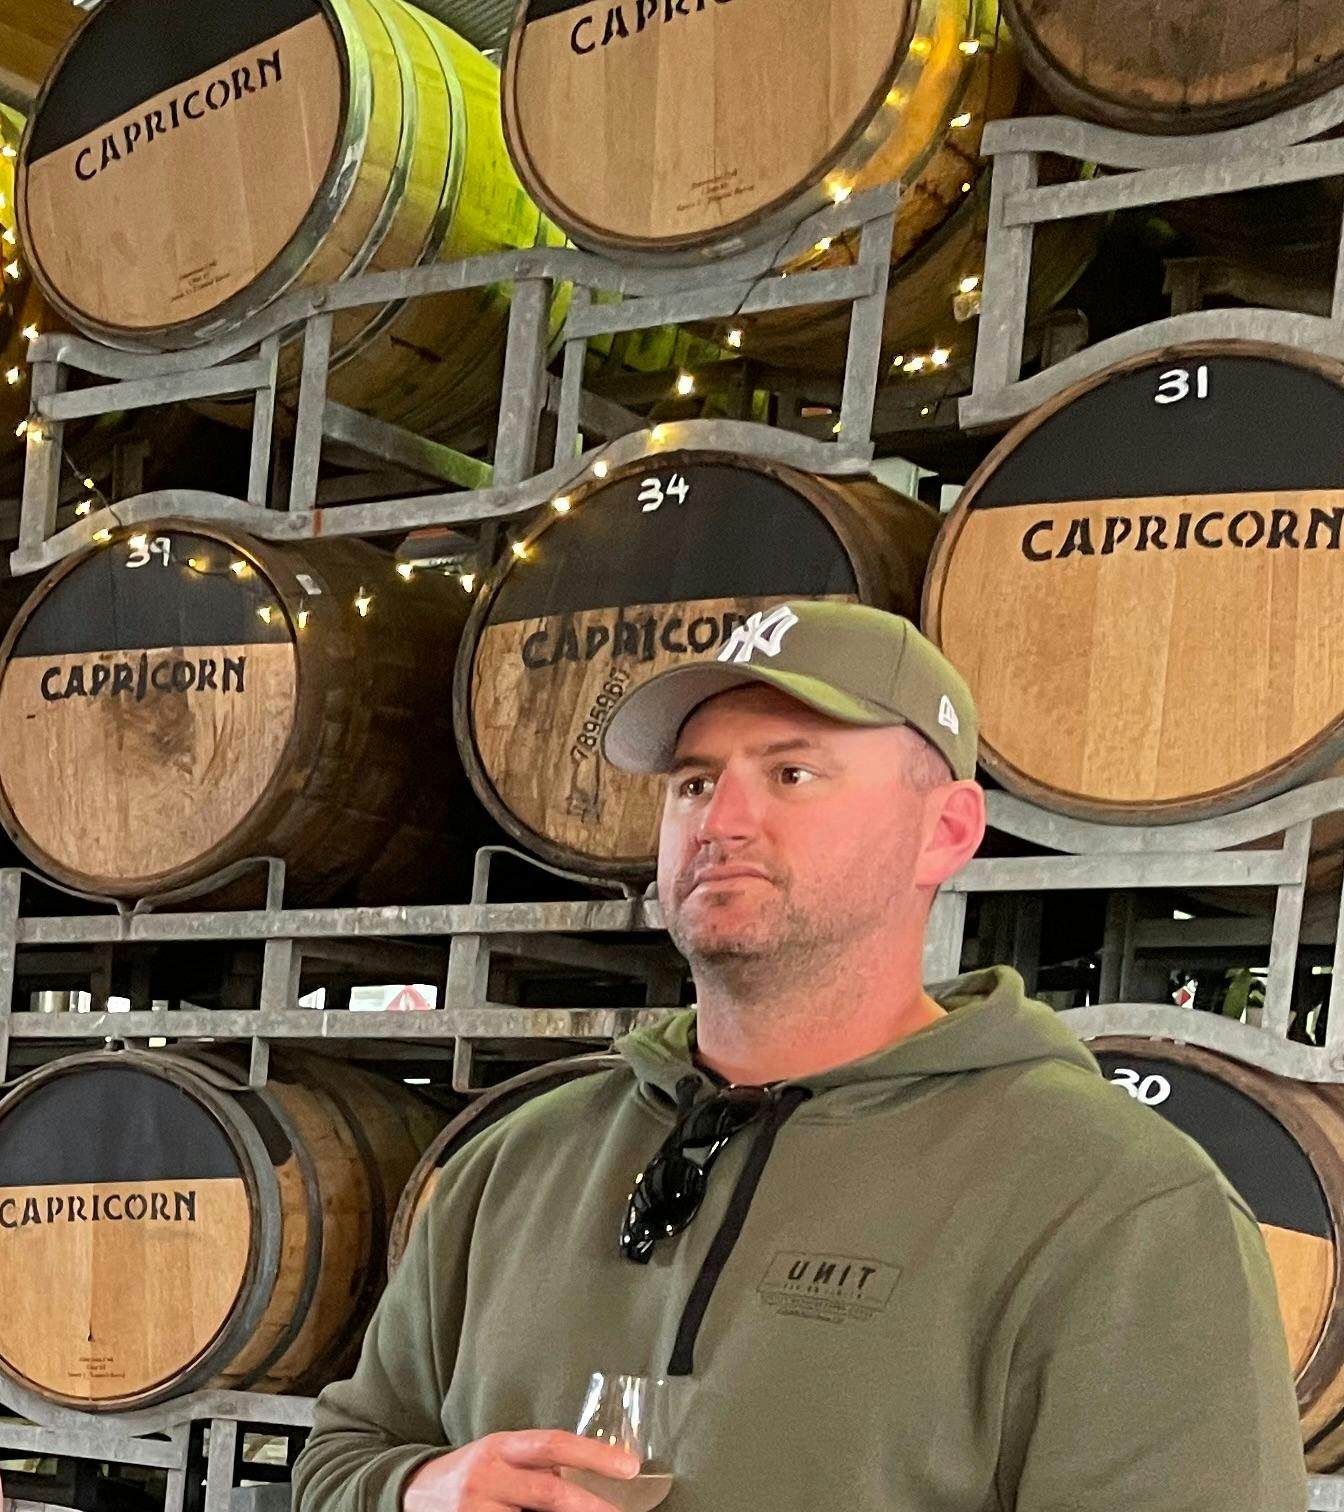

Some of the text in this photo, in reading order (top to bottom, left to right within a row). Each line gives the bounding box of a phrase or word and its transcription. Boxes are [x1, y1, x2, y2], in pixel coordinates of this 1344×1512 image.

[570, 0, 732, 55] CAPR
[75, 48, 282, 181] CAPRICORN
[1154, 365, 1209, 404] 31
[637, 473, 690, 512] 34
[125, 535, 171, 568] 39
[1021, 506, 1344, 562] CAPRICORN
[41, 652, 247, 702] CAPRICORN
[1110, 1068, 1171, 1106] 30
[788, 1260, 876, 1290] UNIT
